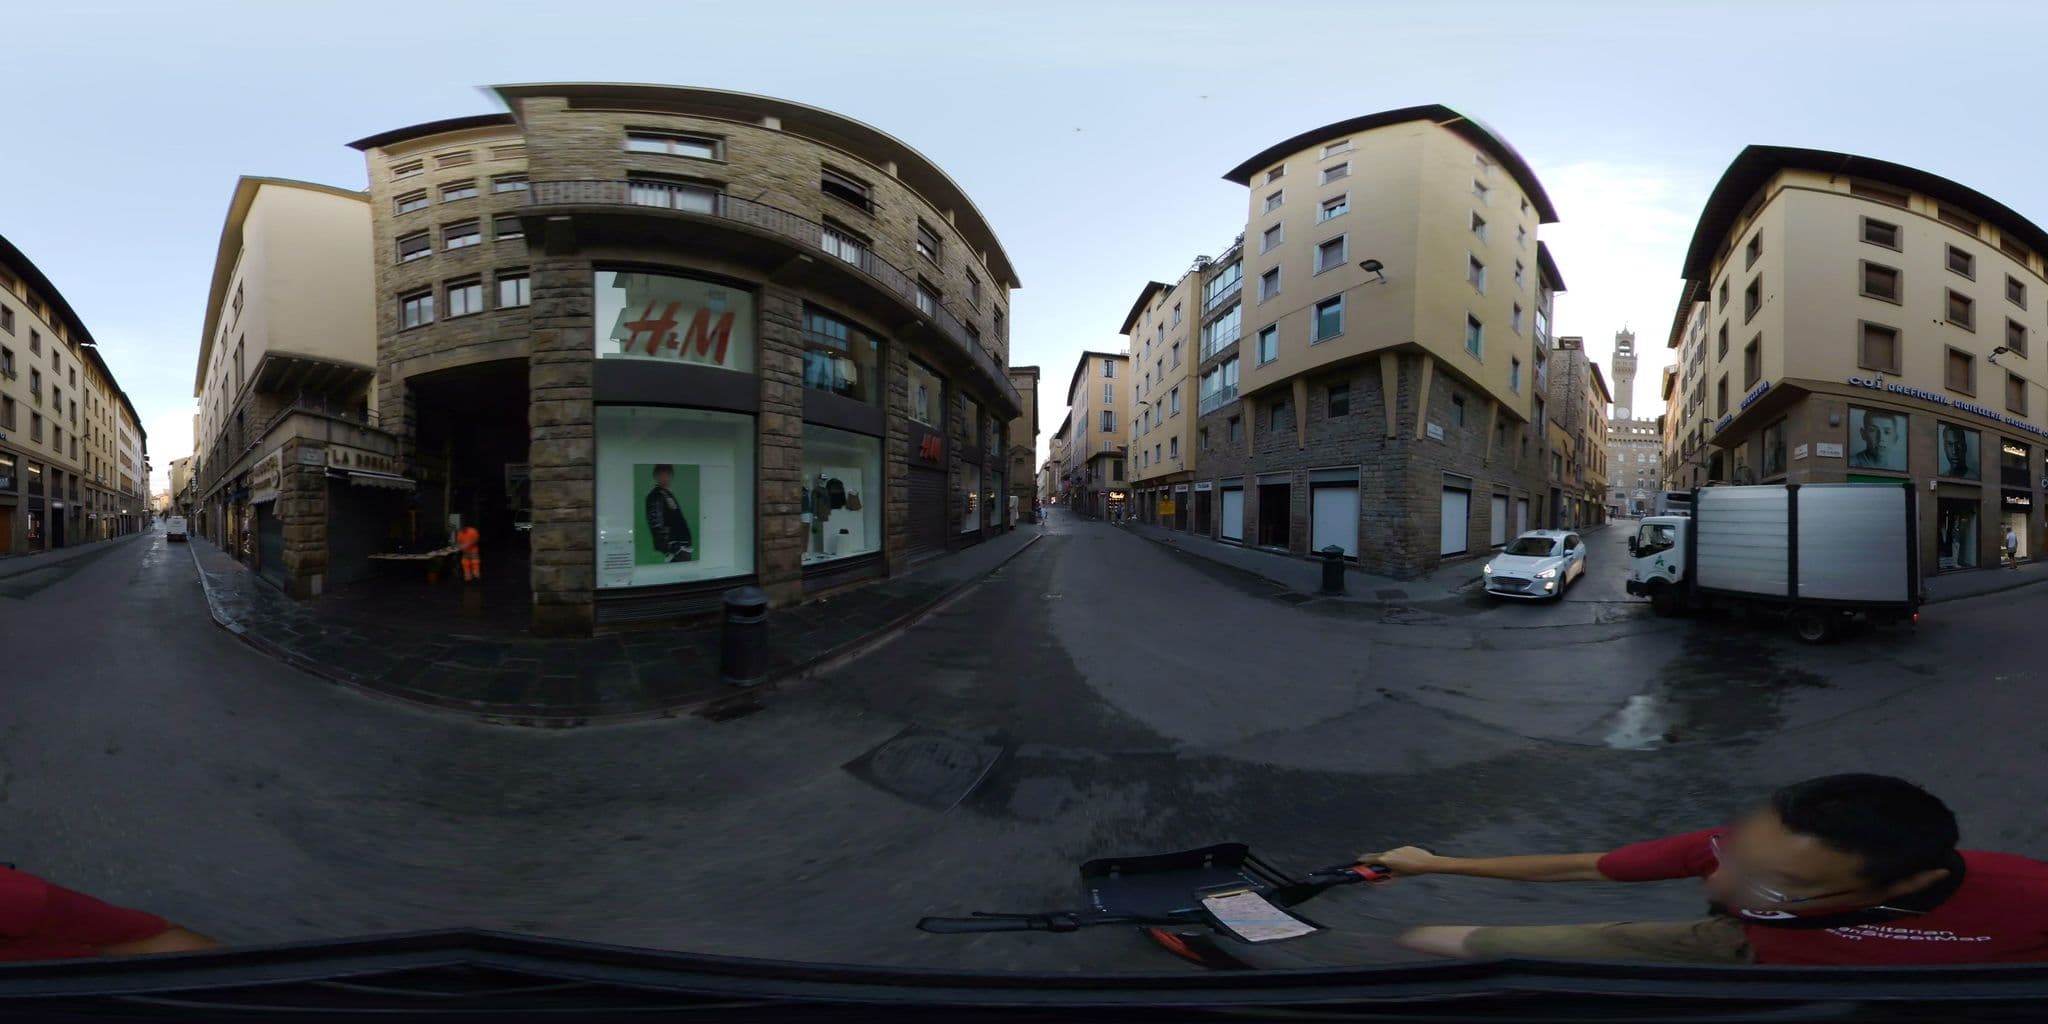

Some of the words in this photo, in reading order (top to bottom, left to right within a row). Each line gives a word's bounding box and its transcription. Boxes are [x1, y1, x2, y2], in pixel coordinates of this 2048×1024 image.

[623, 299, 736, 366] H&M
[1837, 926, 1992, 942] enStreetMap
[1855, 924, 1955, 936] anitarian
